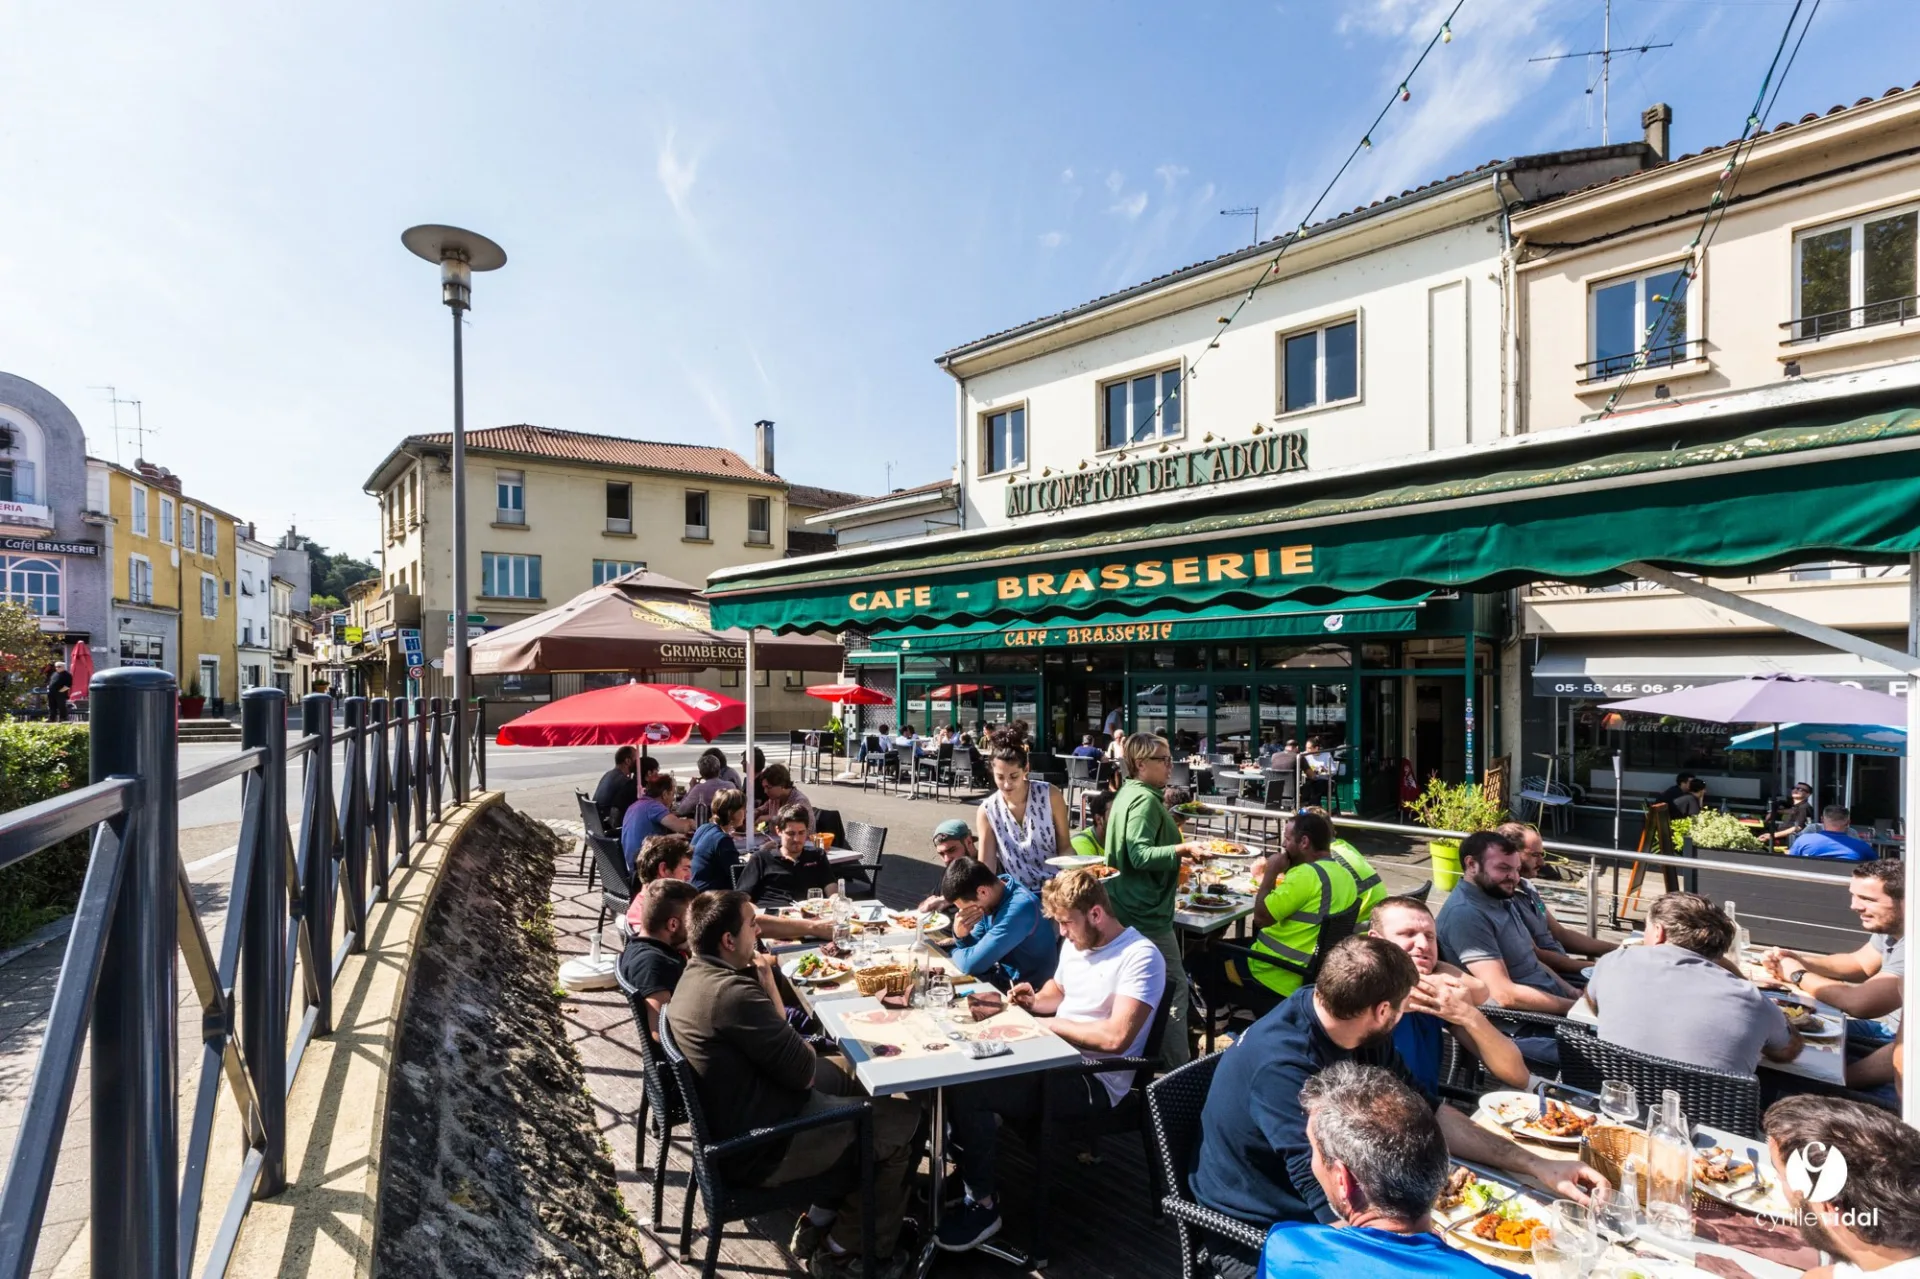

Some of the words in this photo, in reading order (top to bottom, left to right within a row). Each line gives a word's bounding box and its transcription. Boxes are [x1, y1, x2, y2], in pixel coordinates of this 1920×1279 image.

[1006, 483, 1031, 518] AU
[1037, 463, 1140, 511] COMPTOIR
[1146, 455, 1181, 492] DE
[5, 539, 33, 550] Café
[37, 542, 95, 554] BRASSERIE
[848, 585, 932, 611] CAFE
[997, 544, 1314, 600] BRASSERIE
[660, 643, 747, 659] GRIMBERGE
